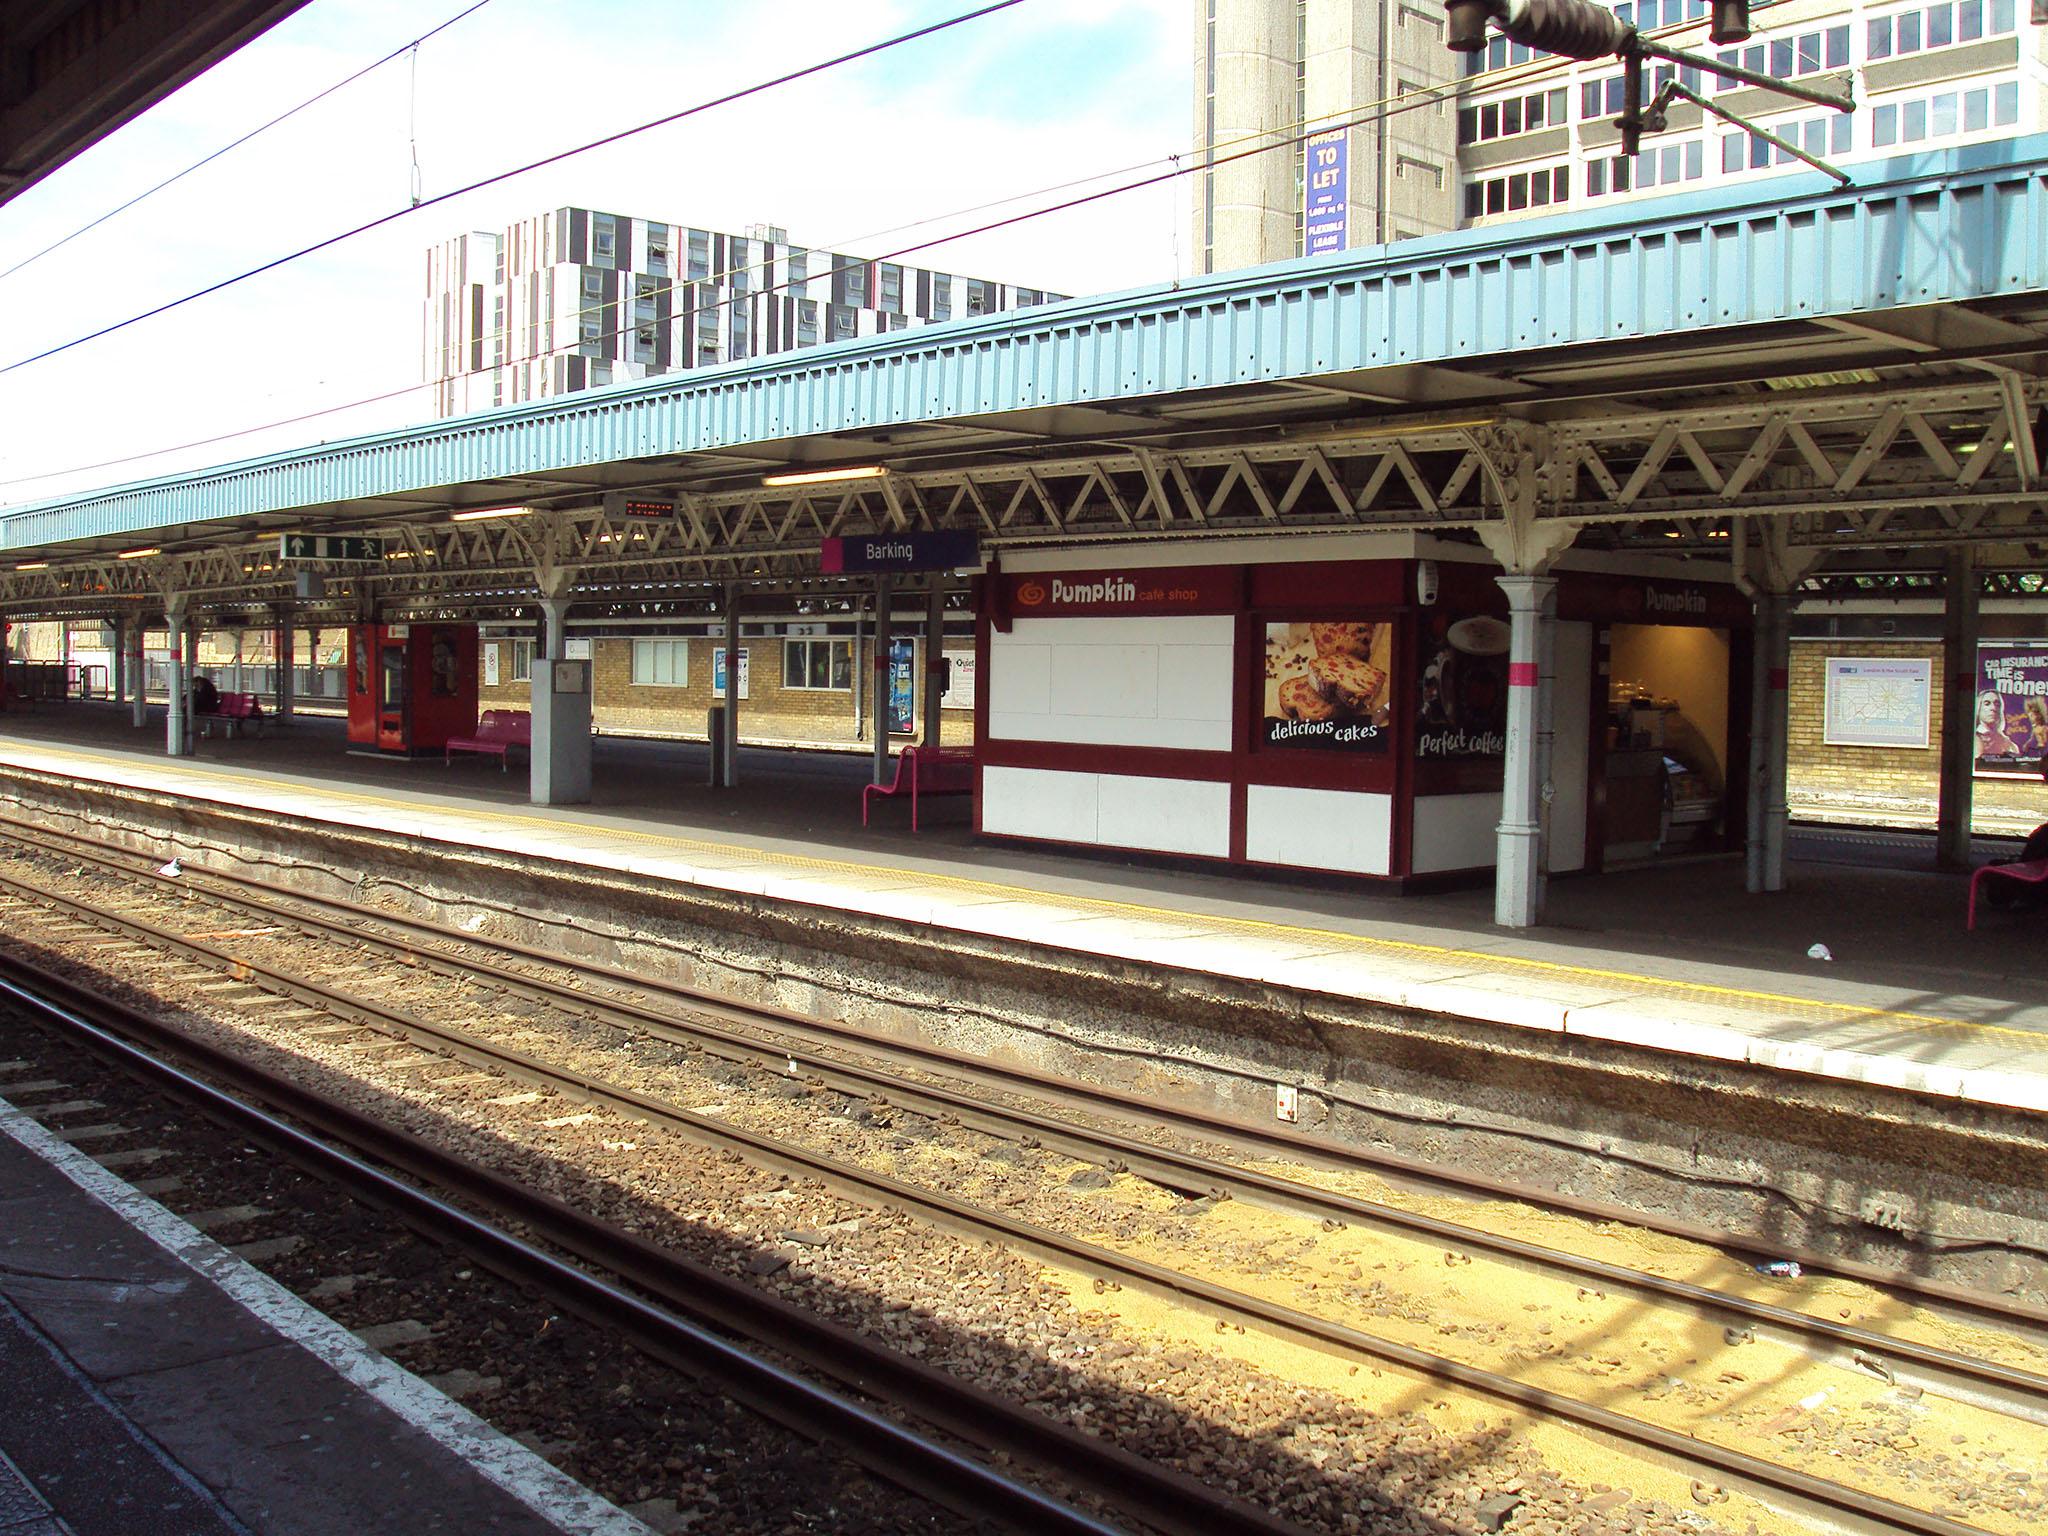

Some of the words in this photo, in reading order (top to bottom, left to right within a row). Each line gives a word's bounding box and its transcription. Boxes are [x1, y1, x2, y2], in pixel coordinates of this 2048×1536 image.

[1316, 147, 1337, 167] TO
[1313, 168, 1340, 190] LET
[866, 541, 913, 561] Barking
[1052, 577, 1135, 604] Pumpkin
[1168, 587, 1198, 602] shop
[1646, 585, 1707, 613] Pumpkin
[1985, 667, 2013, 680] TIME
[1271, 718, 1335, 741] delicious
[1334, 724, 1379, 742] cakes
[1419, 728, 1466, 757] Perfect
